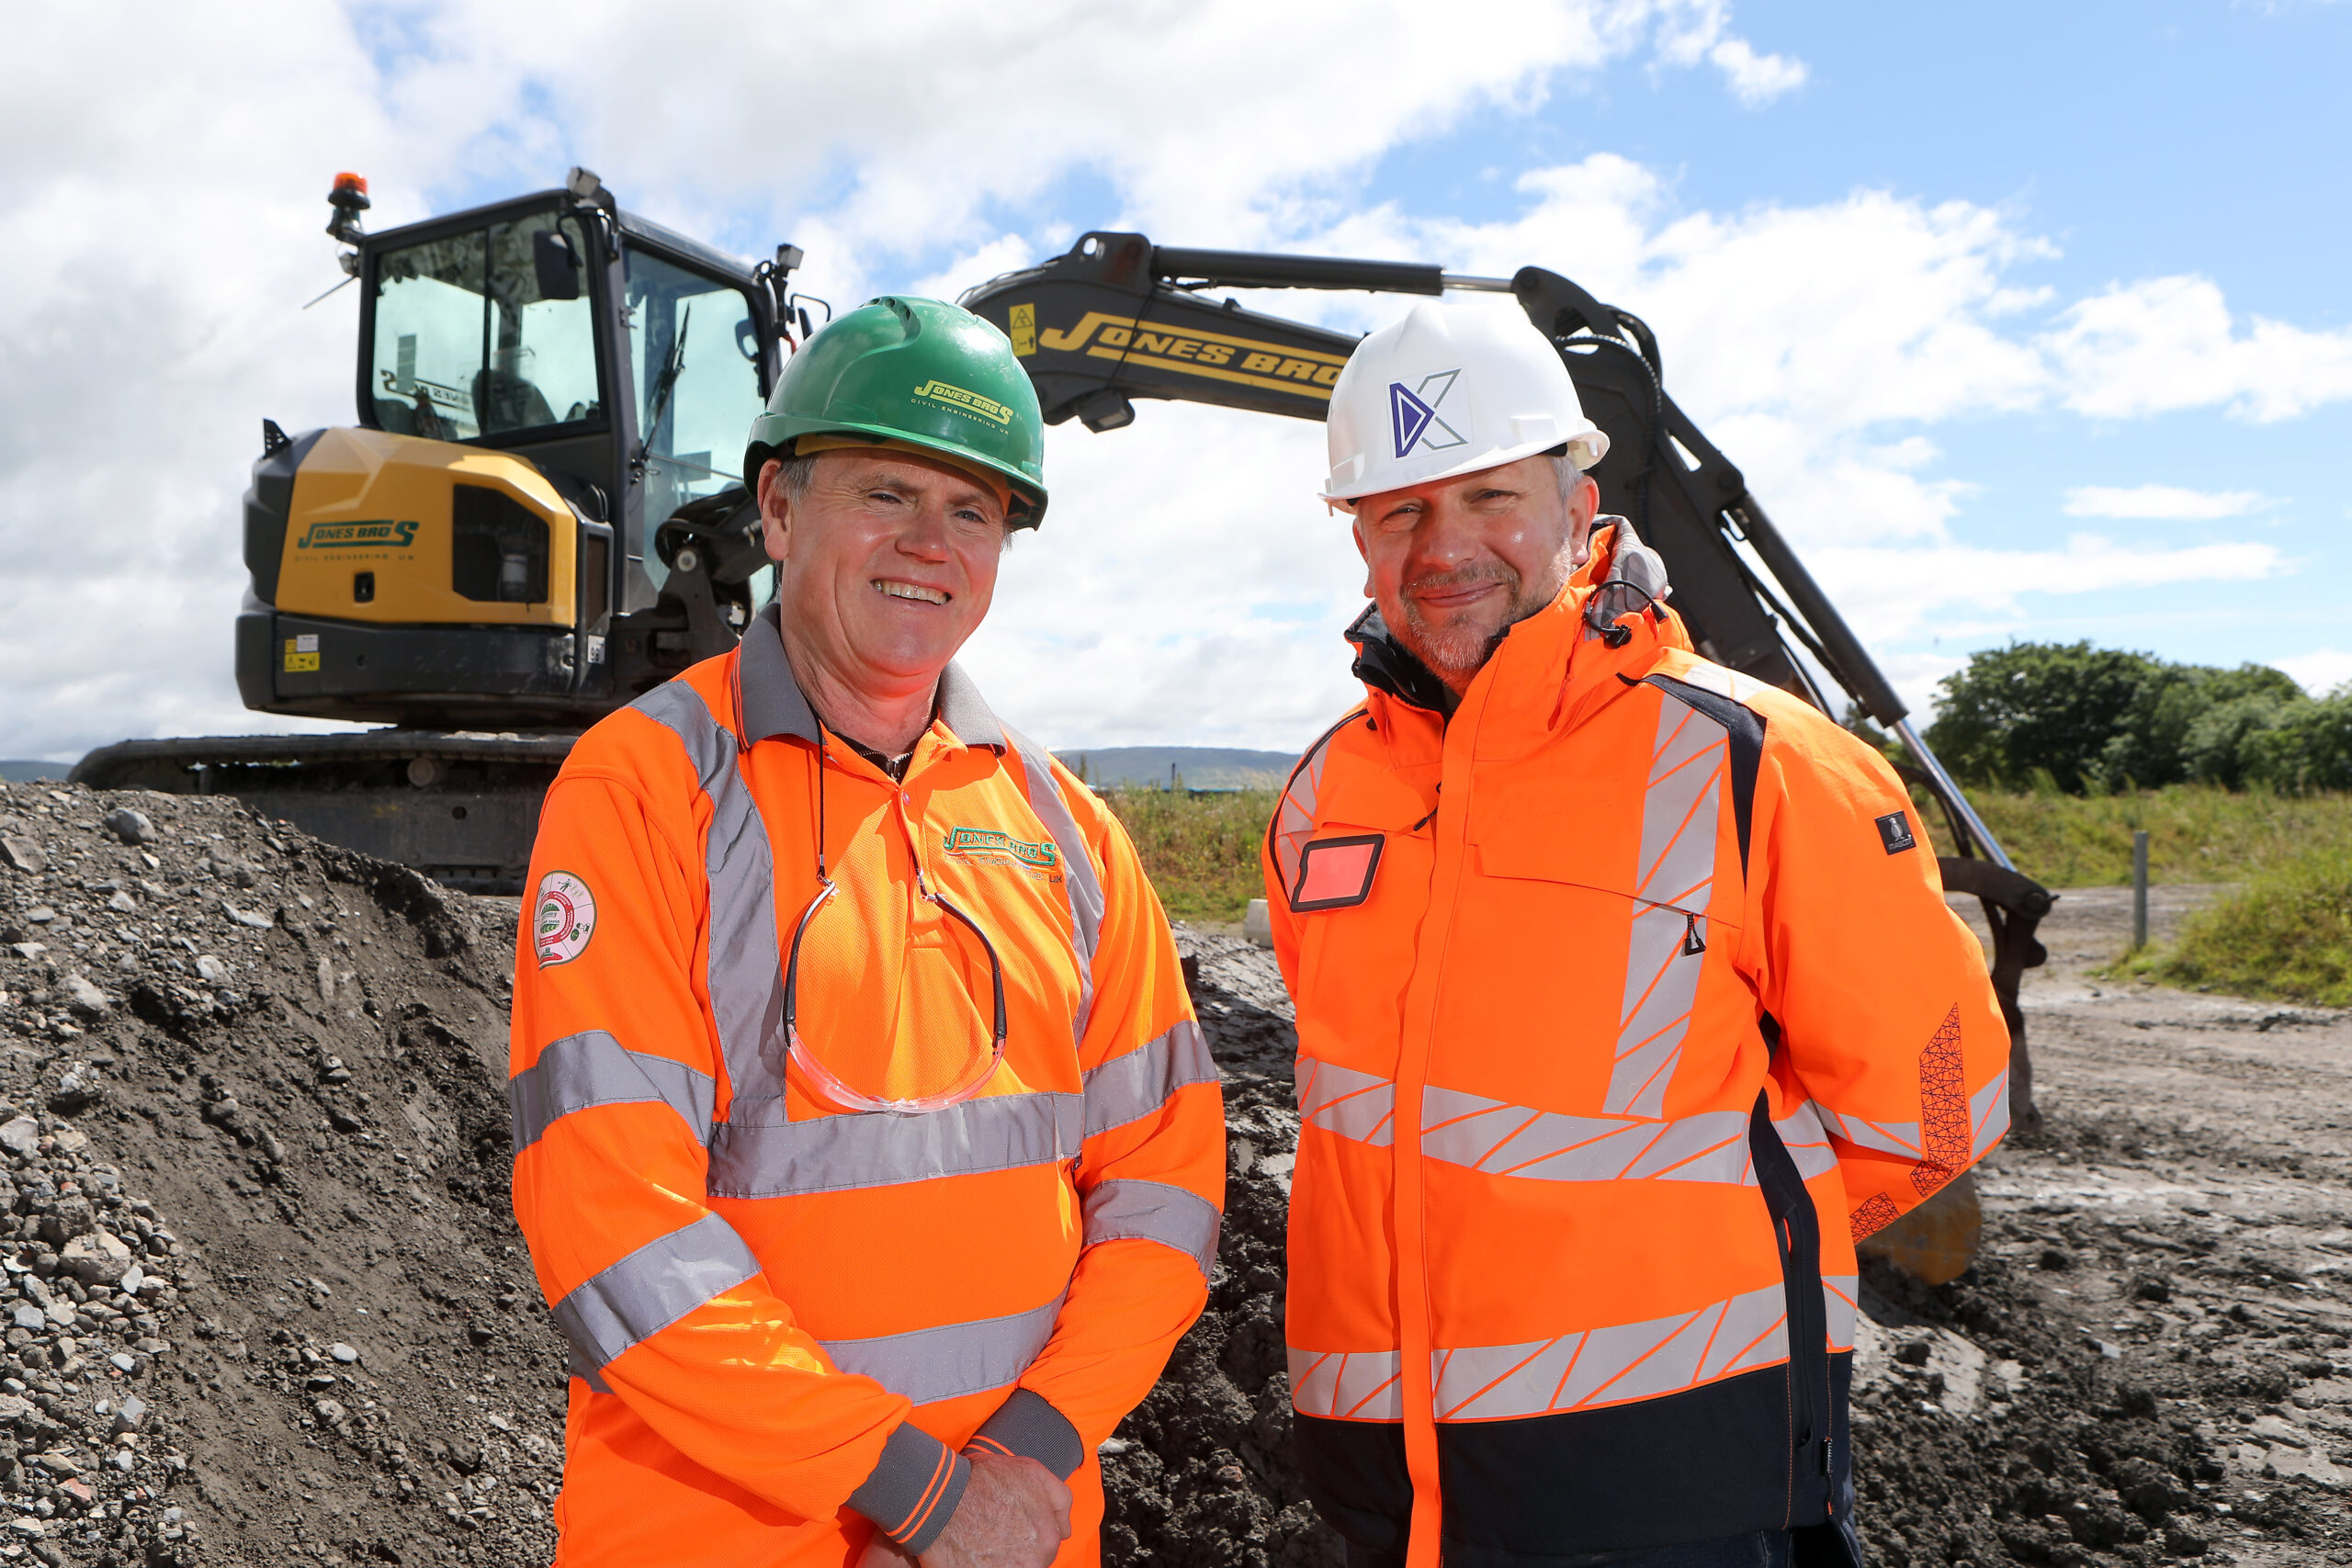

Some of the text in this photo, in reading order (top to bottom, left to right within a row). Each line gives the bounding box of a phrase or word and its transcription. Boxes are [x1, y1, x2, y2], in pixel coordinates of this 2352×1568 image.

[1039, 311, 1236, 365] JONES
[910, 398, 1010, 435] CIVIL ENGINEERING UK
[913, 379, 1014, 425] JONES BROS
[298, 520, 420, 549] JONES BROS
[944, 826, 1056, 866] JONES BROS
